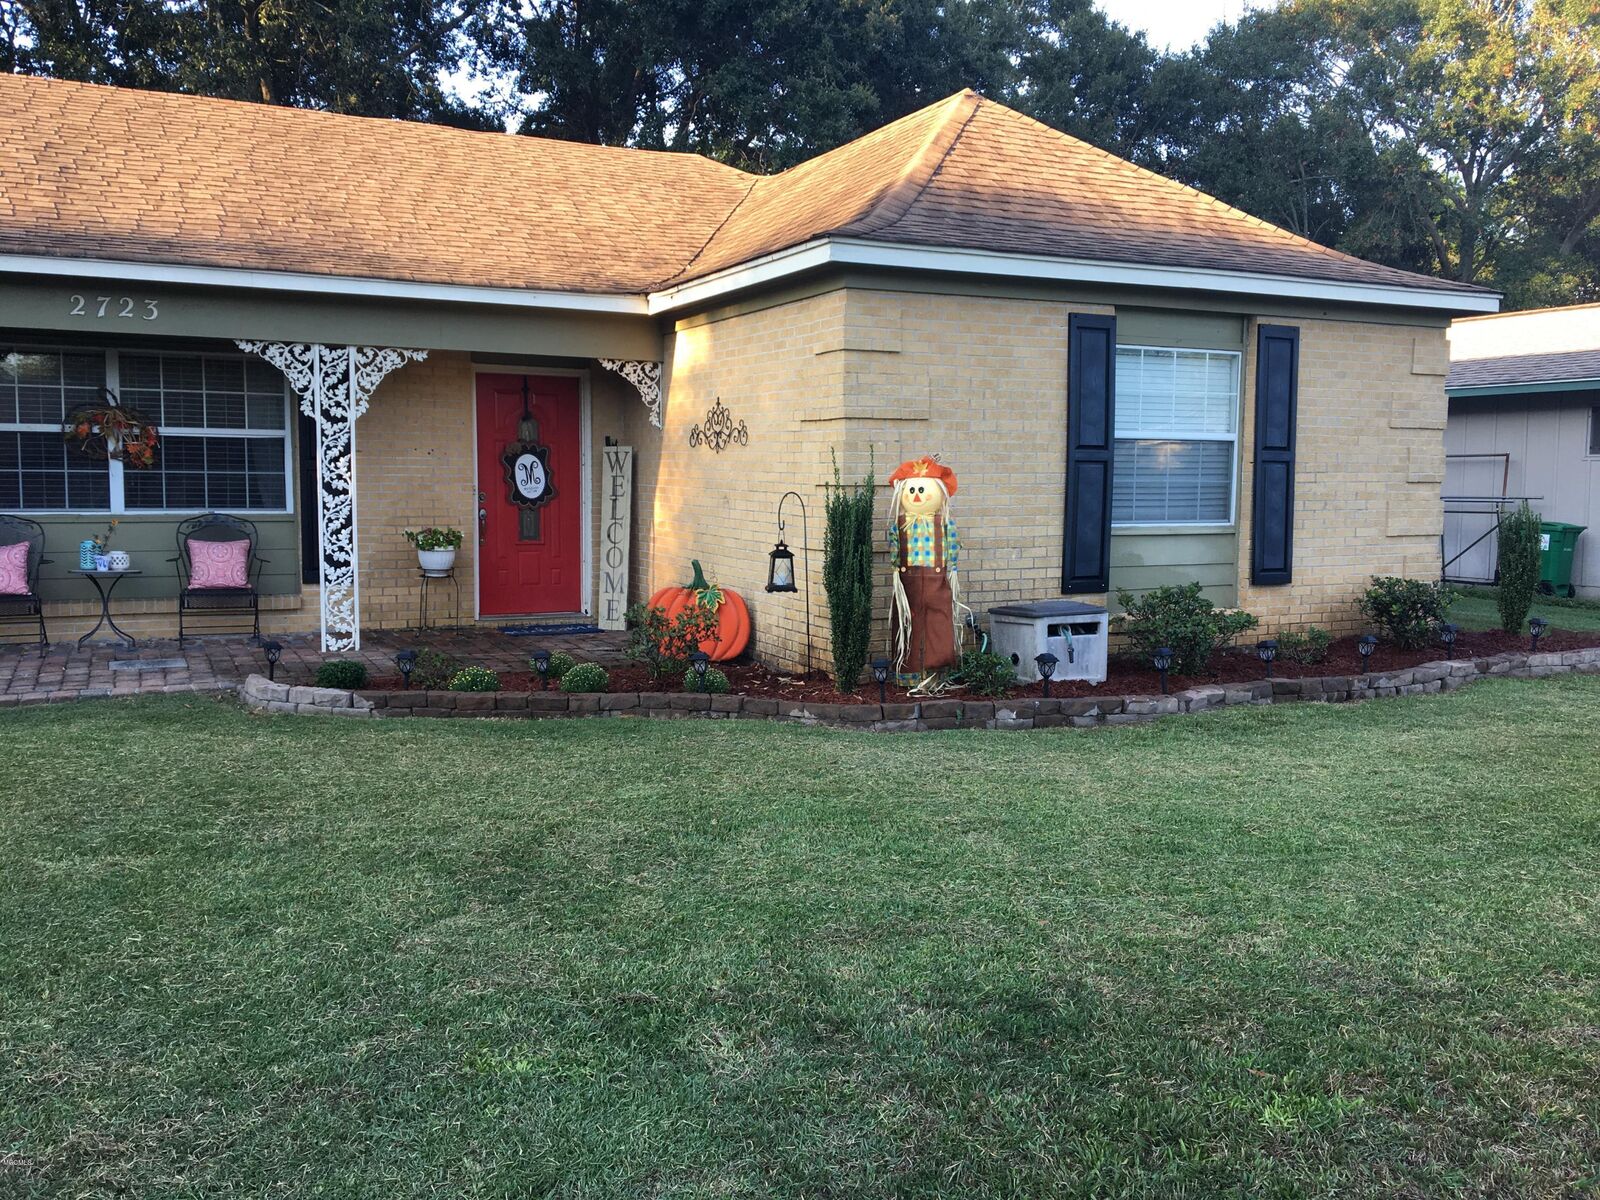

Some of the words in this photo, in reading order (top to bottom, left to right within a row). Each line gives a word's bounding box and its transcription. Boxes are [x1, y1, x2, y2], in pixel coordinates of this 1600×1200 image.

[70, 294, 159, 320] 2723
[517, 460, 541, 487] M
[604, 451, 630, 622] WELCOME
